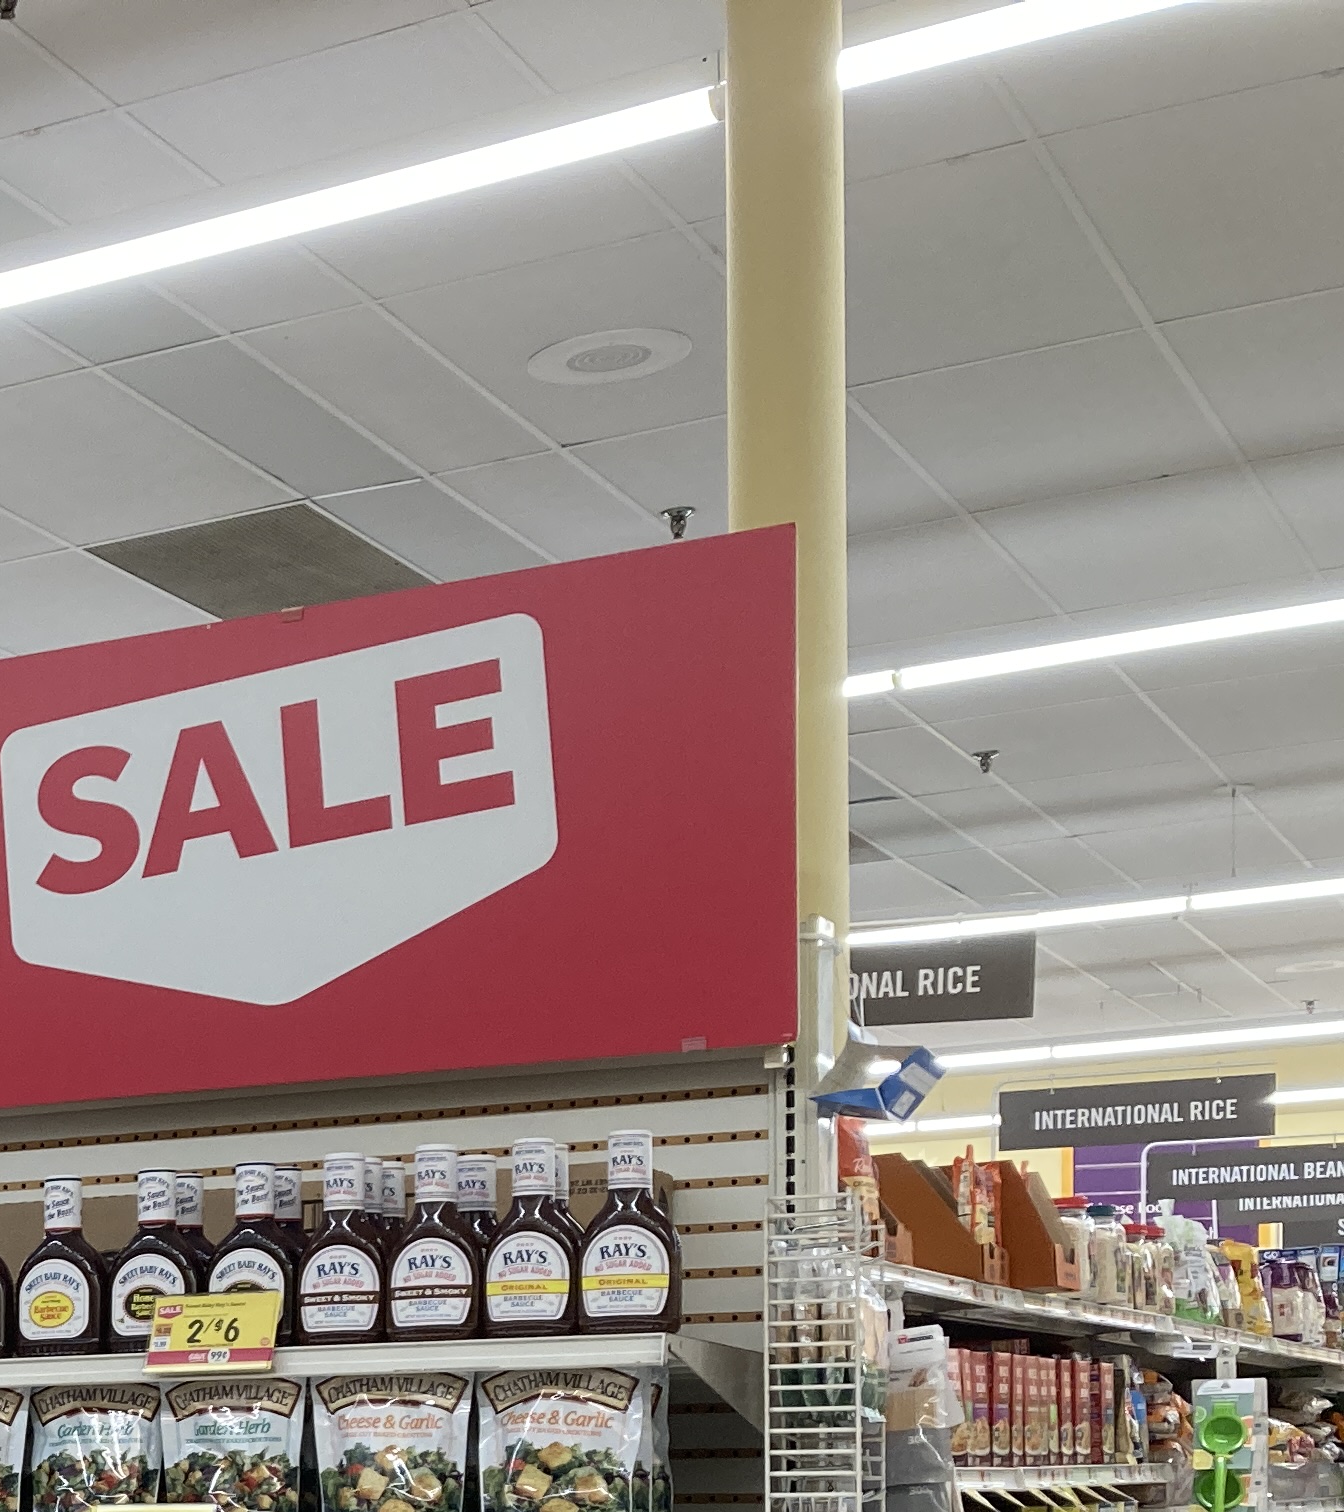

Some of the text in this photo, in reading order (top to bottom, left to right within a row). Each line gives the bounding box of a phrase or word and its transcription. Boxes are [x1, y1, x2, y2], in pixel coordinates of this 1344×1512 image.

[36, 658, 515, 896] SALE
[917, 965, 981, 996] RICE
[1034, 1099, 1238, 1131] INTERNATIONAL RICE
[1173, 1164, 1298, 1186] INTERNATIONAL
[503, 1251, 547, 1266] RAY'S
[600, 1244, 647, 1259] RAY'S
[408, 1255, 452, 1269] RAY'S
[598, 1278, 648, 1286] ORIGINAL
[159, 1306, 182, 1315] SALE
[493, 1371, 627, 1401] CHATHAM VILLAGE
[399, 1414, 443, 1430] Garlic
[564, 1410, 614, 1428] Garlic
